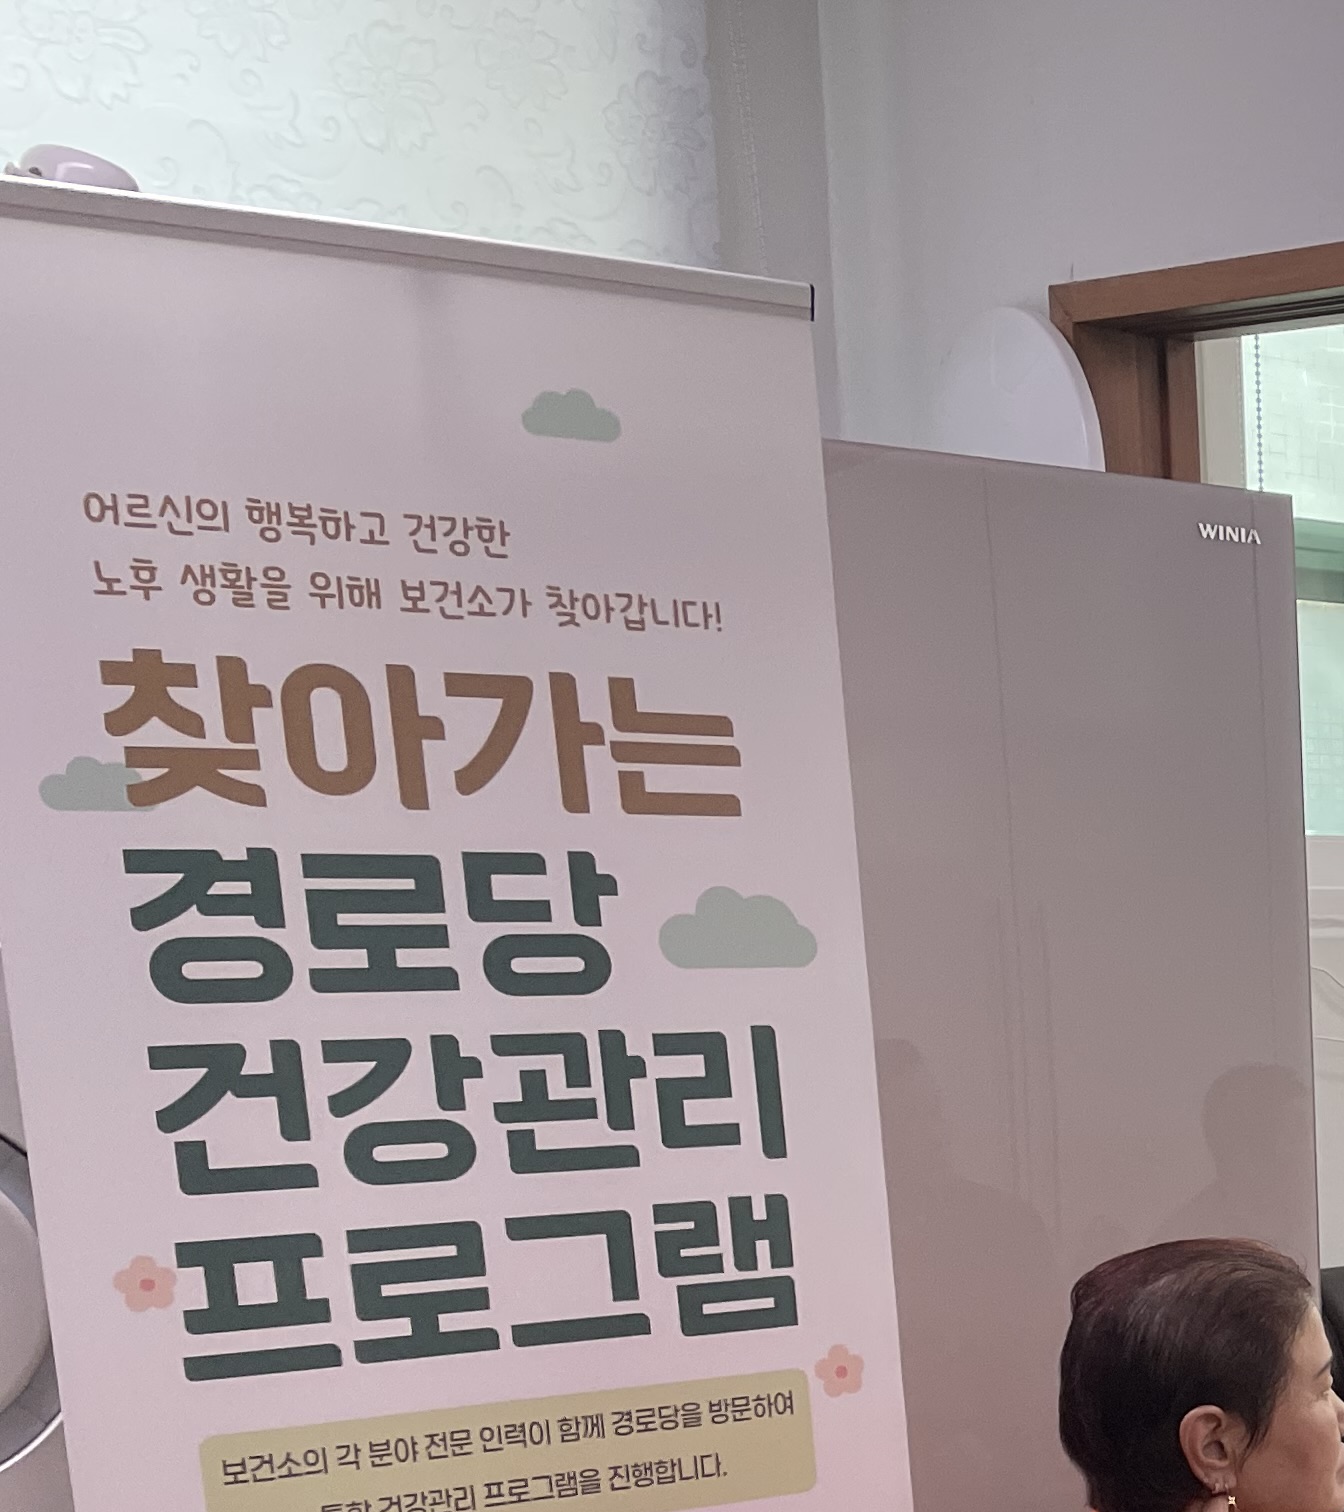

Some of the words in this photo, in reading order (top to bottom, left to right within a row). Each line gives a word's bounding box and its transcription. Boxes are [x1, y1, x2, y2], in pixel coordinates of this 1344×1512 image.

[83, 491, 231, 536] 어르신의
[245, 496, 390, 547] 행복하고
[403, 514, 511, 560] 건강한
[1198, 522, 1261, 545] WINIA
[93, 558, 163, 601] 노후
[180, 562, 291, 610] 생활을
[308, 571, 382, 611] 위해
[399, 578, 533, 621] 보건소가
[546, 585, 723, 633] 찾아갑니다!
[98, 649, 742, 816] 찾아가는
[122, 847, 619, 1004] 경로당
[147, 1025, 788, 1196] 건강관리
[174, 1194, 799, 1381] 프로그램
[221, 1448, 329, 1488] 보건소의
[335, 1442, 363, 1472] 각
[368, 1435, 420, 1469] 분야
[423, 1428, 474, 1462] 전문
[478, 1418, 552, 1455] 인력이
[557, 1410, 606, 1444] 함께
[610, 1399, 703, 1439] 경로당을
[707, 1389, 796, 1425] 방문하여
[483, 1469, 602, 1511] 프로그램을
[607, 1453, 728, 1493] 진행합니다.
